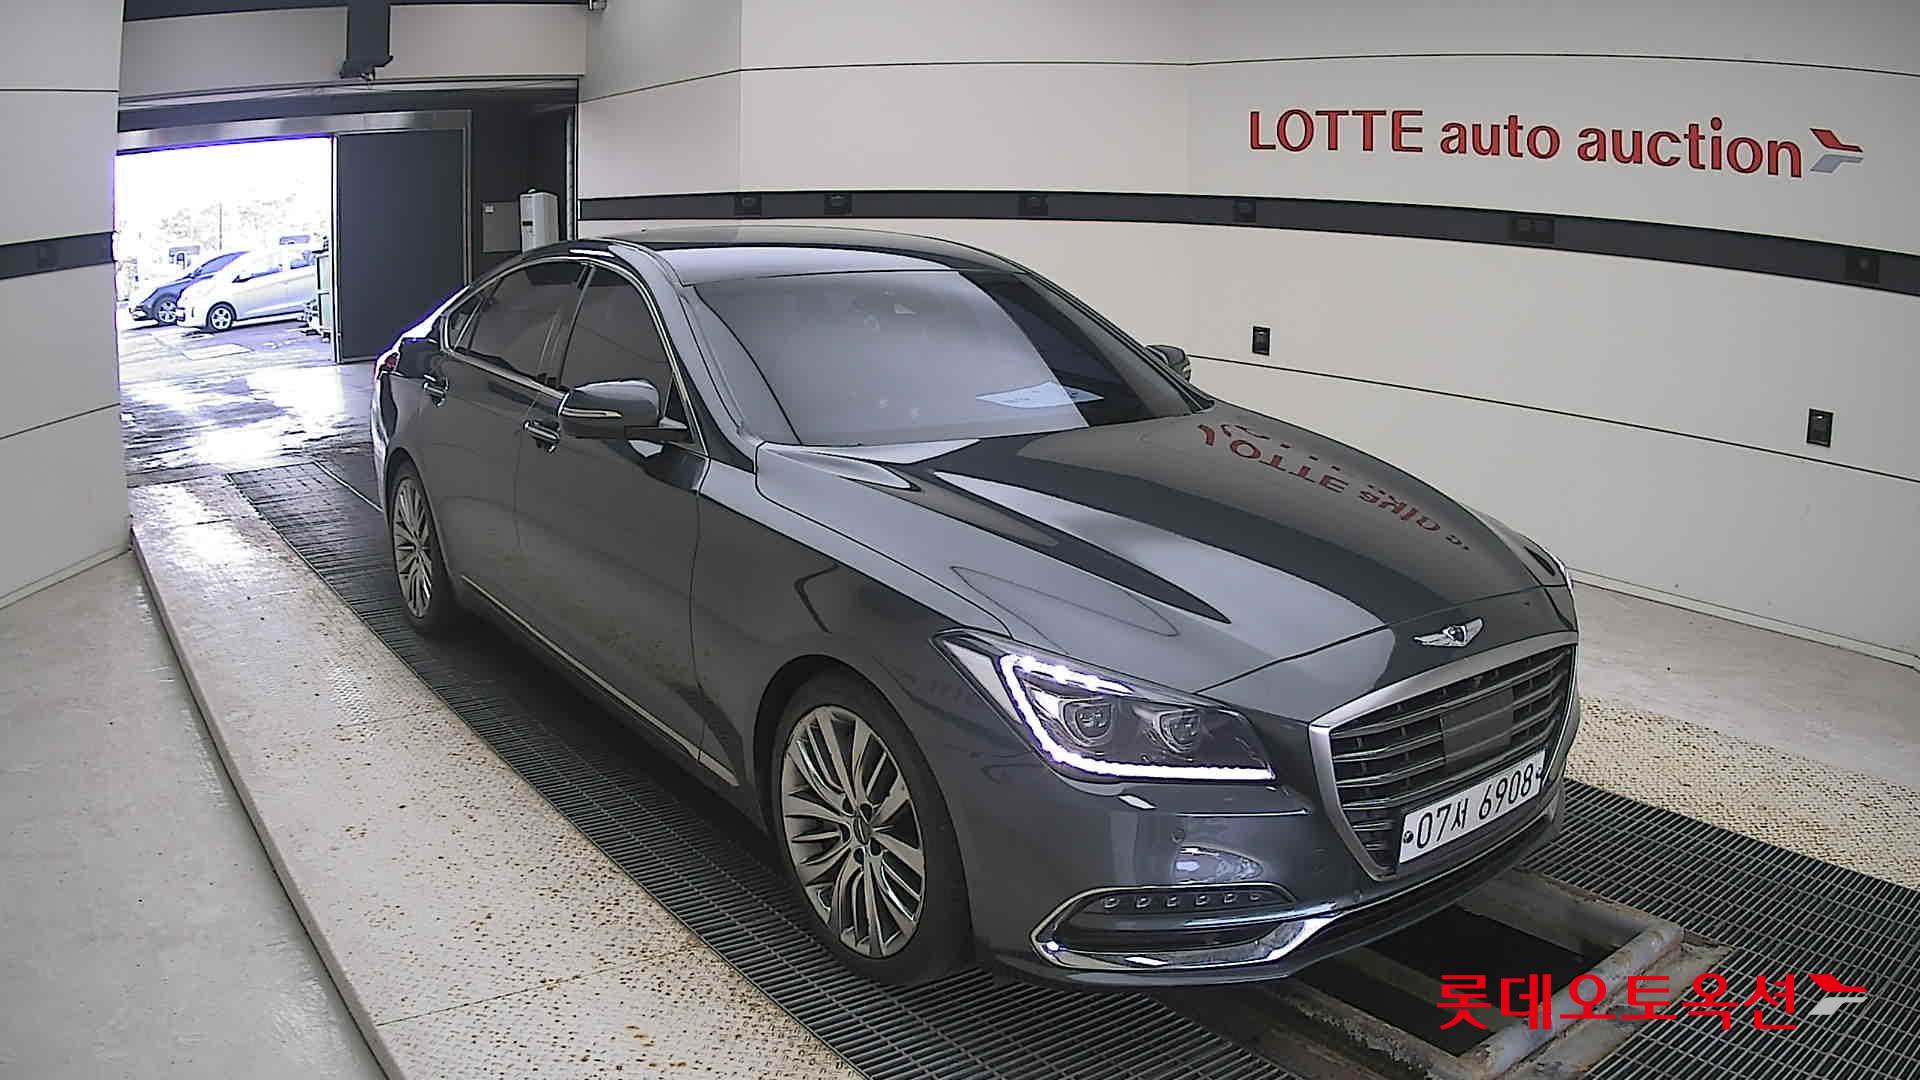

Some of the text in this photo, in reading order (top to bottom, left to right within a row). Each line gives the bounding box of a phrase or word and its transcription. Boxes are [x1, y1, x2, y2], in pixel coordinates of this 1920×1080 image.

[1249, 109, 1803, 178] LOTTE auto auction
[1416, 763, 1534, 849] 07서 6908
